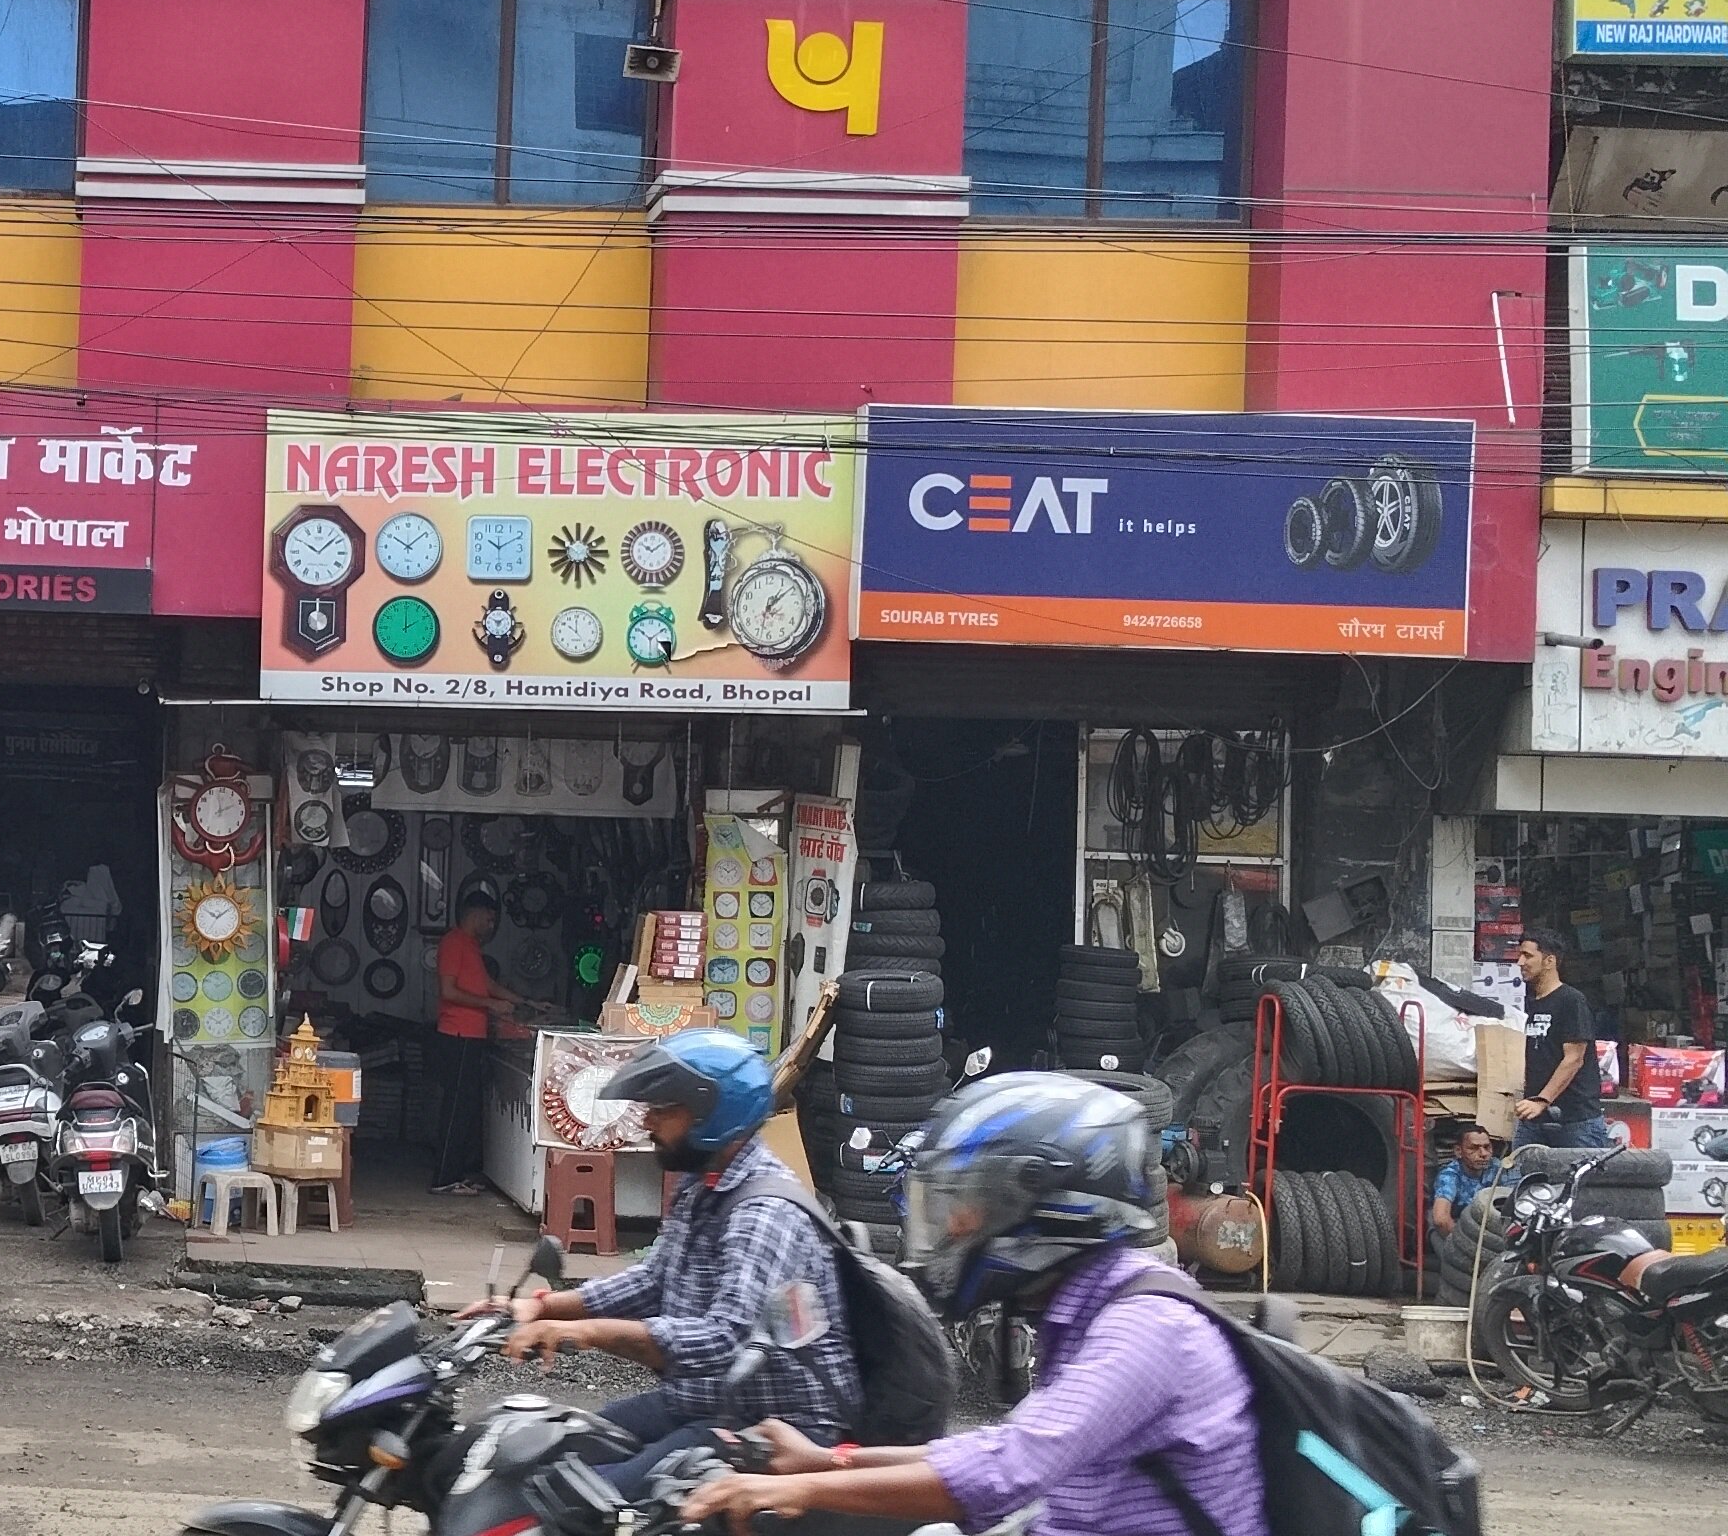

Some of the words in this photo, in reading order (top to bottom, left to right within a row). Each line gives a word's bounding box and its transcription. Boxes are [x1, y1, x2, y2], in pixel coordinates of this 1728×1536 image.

[1596, 24, 1626, 43] NEW
[1629, 24, 1653, 43] RAJ
[287, 444, 494, 499] NARESH
[518, 445, 834, 499] ELECTRONIC
[908, 473, 1108, 533] CEAT
[1119, 517, 1133, 533] it
[1142, 518, 1197, 537] helps
[4, 506, 129, 548] भोपाल
[881, 609, 946, 626] SOURAB
[949, 611, 999, 627] TYRES
[1122, 614, 1203, 630] 9424726658
[1338, 620, 1386, 638] सौरभ
[1396, 621, 1445, 641] टायर्स
[320, 677, 383, 699] Shop
[393, 678, 438, 696] No.
[444, 677, 496, 699] 2/8,
[505, 679, 629, 702] Hamidiya
[639, 682, 712, 703] Road,
[722, 684, 812, 705] Bhopal
